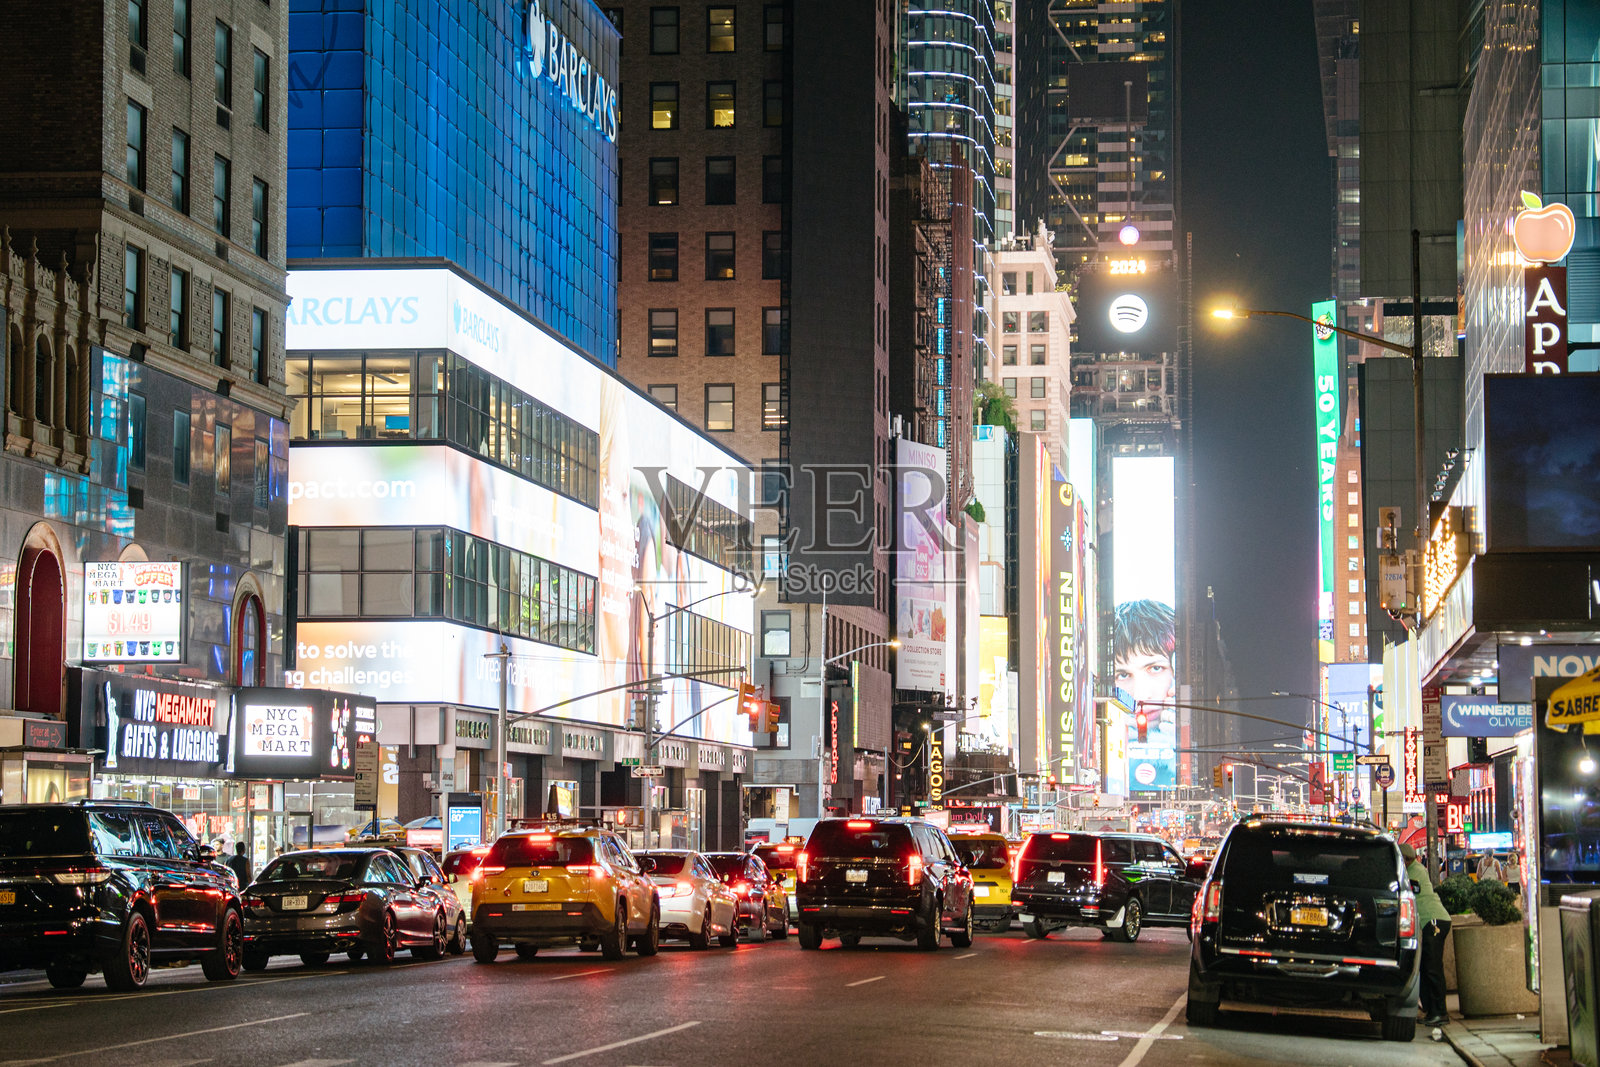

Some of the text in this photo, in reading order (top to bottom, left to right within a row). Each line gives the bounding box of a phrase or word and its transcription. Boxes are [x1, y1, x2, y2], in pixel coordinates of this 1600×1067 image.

[549, 22, 617, 142] BARCLAYS
[1110, 260, 1147, 274] 2024
[462, 309, 499, 352] BARCLAYS
[1318, 374, 1336, 522] 50 YEARS
[908, 448, 937, 470] MINISO
[288, 479, 416, 504] pact.com
[97, 563, 172, 575] NYC SPECIAL
[89, 571, 174, 587] MEGA OFFER
[108, 611, 153, 636] $1.49
[298, 640, 414, 659] to solve the
[309, 666, 414, 688] challenges
[1060, 572, 1074, 784] THIS SCREEN
[134, 689, 216, 727] NYC MEGAMART
[266, 709, 297, 721] NYC
[1458, 705, 1515, 716] WINNER!
[30, 725, 43, 737] Enter
[252, 724, 300, 736] MEGA
[1489, 717, 1533, 727] OLIVIER
[123, 723, 219, 762] GIFTS & LUGGAGE
[262, 741, 310, 753] MART
[930, 732, 943, 801] LAGOS
[185, 788, 198, 799] EXIT
[1405, 794, 1448, 804] TAVRN
